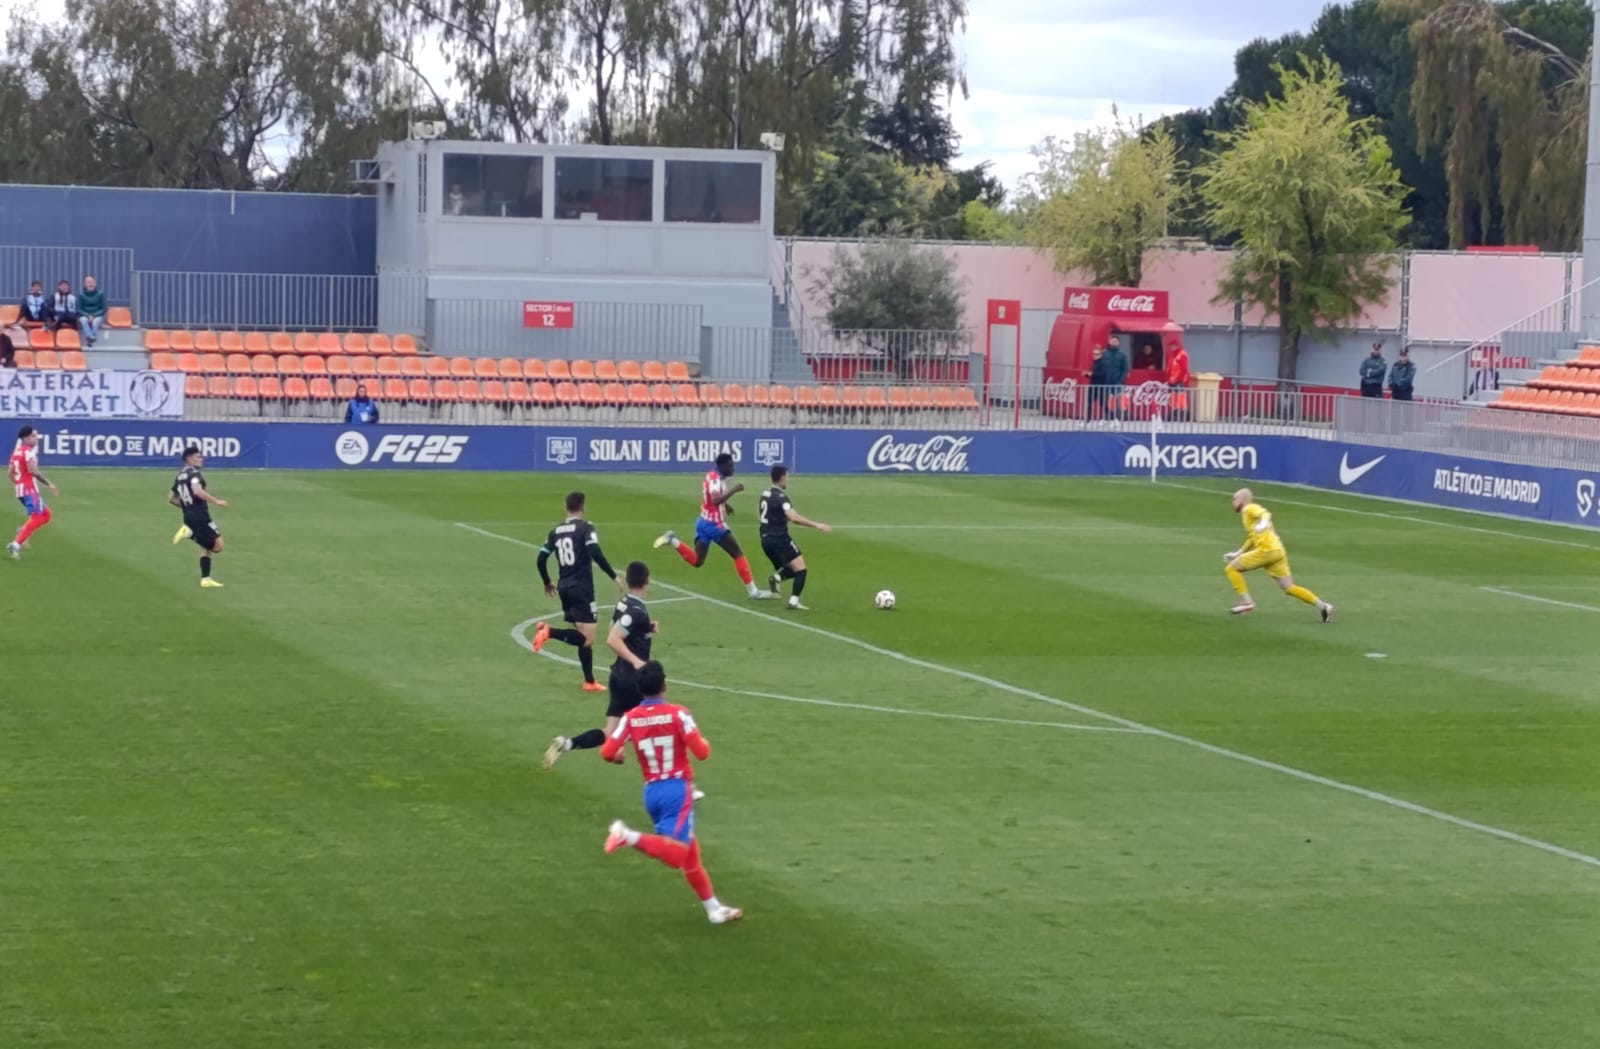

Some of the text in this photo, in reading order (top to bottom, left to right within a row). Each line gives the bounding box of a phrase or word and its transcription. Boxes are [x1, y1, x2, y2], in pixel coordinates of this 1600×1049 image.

[526, 304, 553, 312] SECTOR
[1108, 295, 1155, 312] Coca-Cola
[542, 314, 555, 326] 12
[126, 438, 144, 453] DE
[148, 436, 241, 457] MADRID
[343, 438, 361, 449] EA
[649, 440, 670, 461] DE
[676, 440, 742, 462] CABRAS
[867, 434, 974, 471] Coca-Cola
[1155, 444, 1257, 470] kraken
[1433, 466, 1483, 496] ATLÉTICO
[1493, 477, 1540, 504] MADRID
[761, 500, 769, 524] 2
[555, 537, 575, 567] 18
[638, 735, 674, 773] 17
